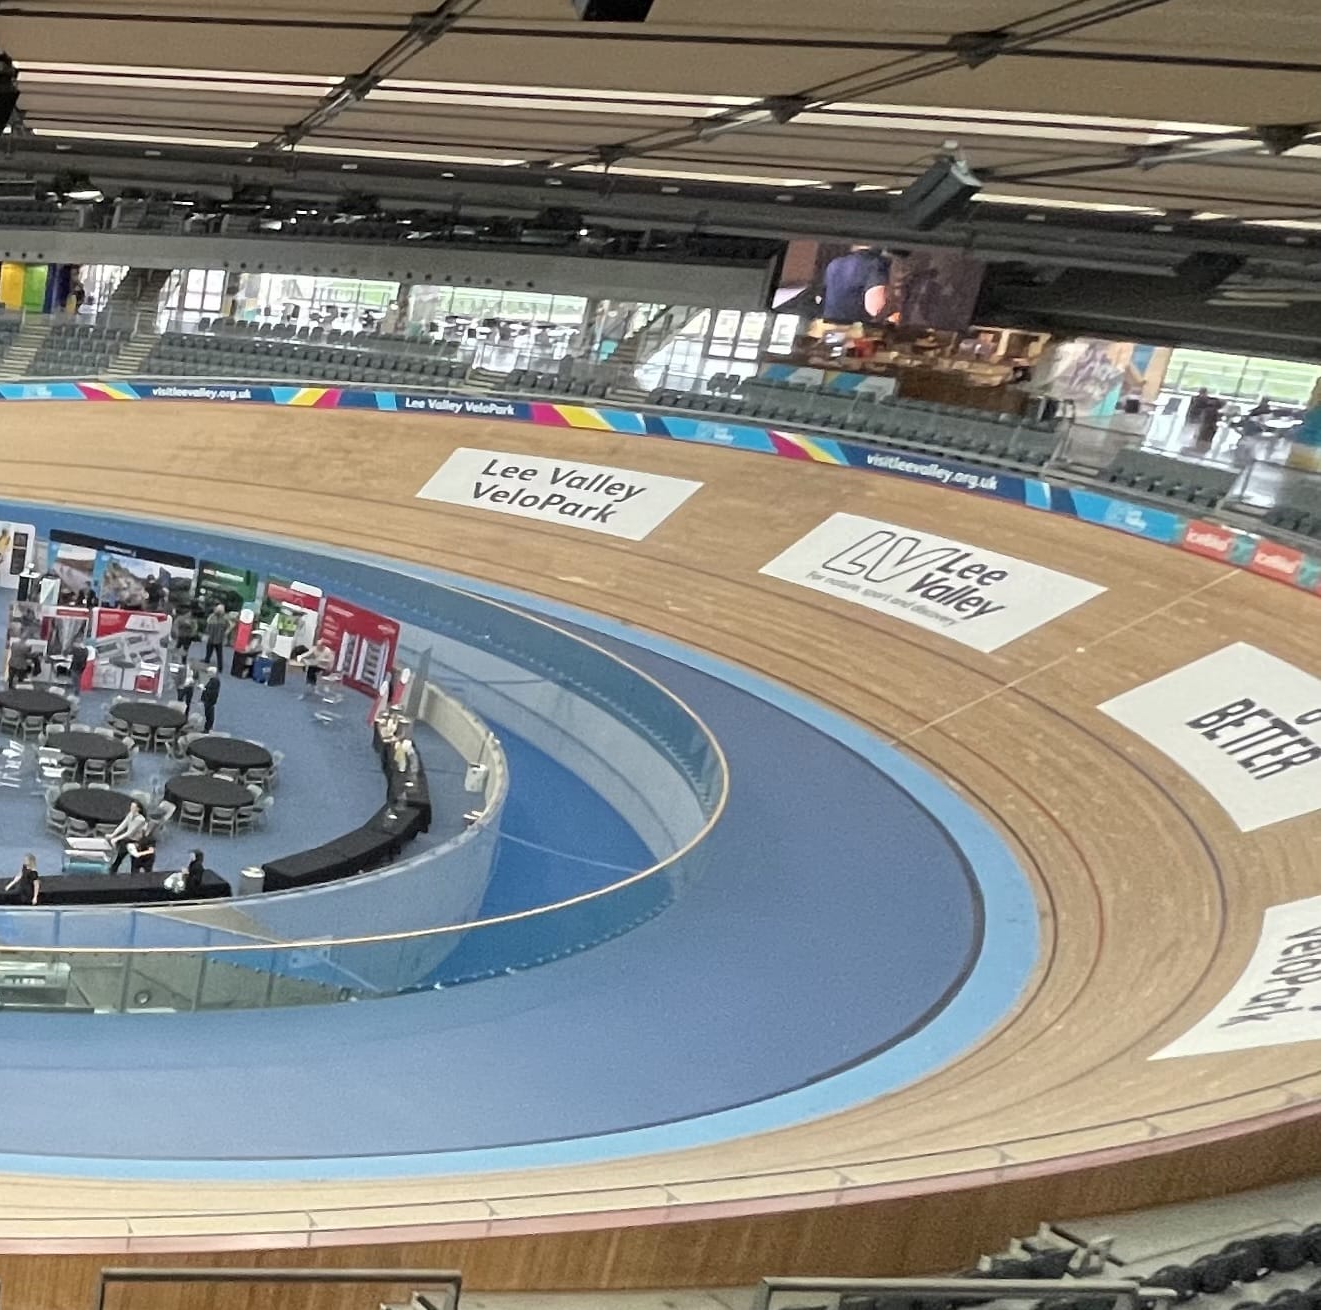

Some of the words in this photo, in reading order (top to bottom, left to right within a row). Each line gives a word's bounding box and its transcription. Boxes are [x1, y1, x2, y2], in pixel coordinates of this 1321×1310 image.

[152, 387, 252, 400] visitleevalley.org.uk
[405, 397, 426, 409] Lee
[427, 398, 462, 413] Valley
[465, 401, 515, 416] VeloPark
[481, 459, 538, 481] Lee
[550, 467, 647, 503] Valley
[867, 453, 999, 490] visitleevalley.org.uk
[472, 481, 619, 524] VeloPark
[935, 552, 1009, 587] Lee
[905, 572, 1007, 621] Valley
[1185, 698, 1321, 780] BETTER
